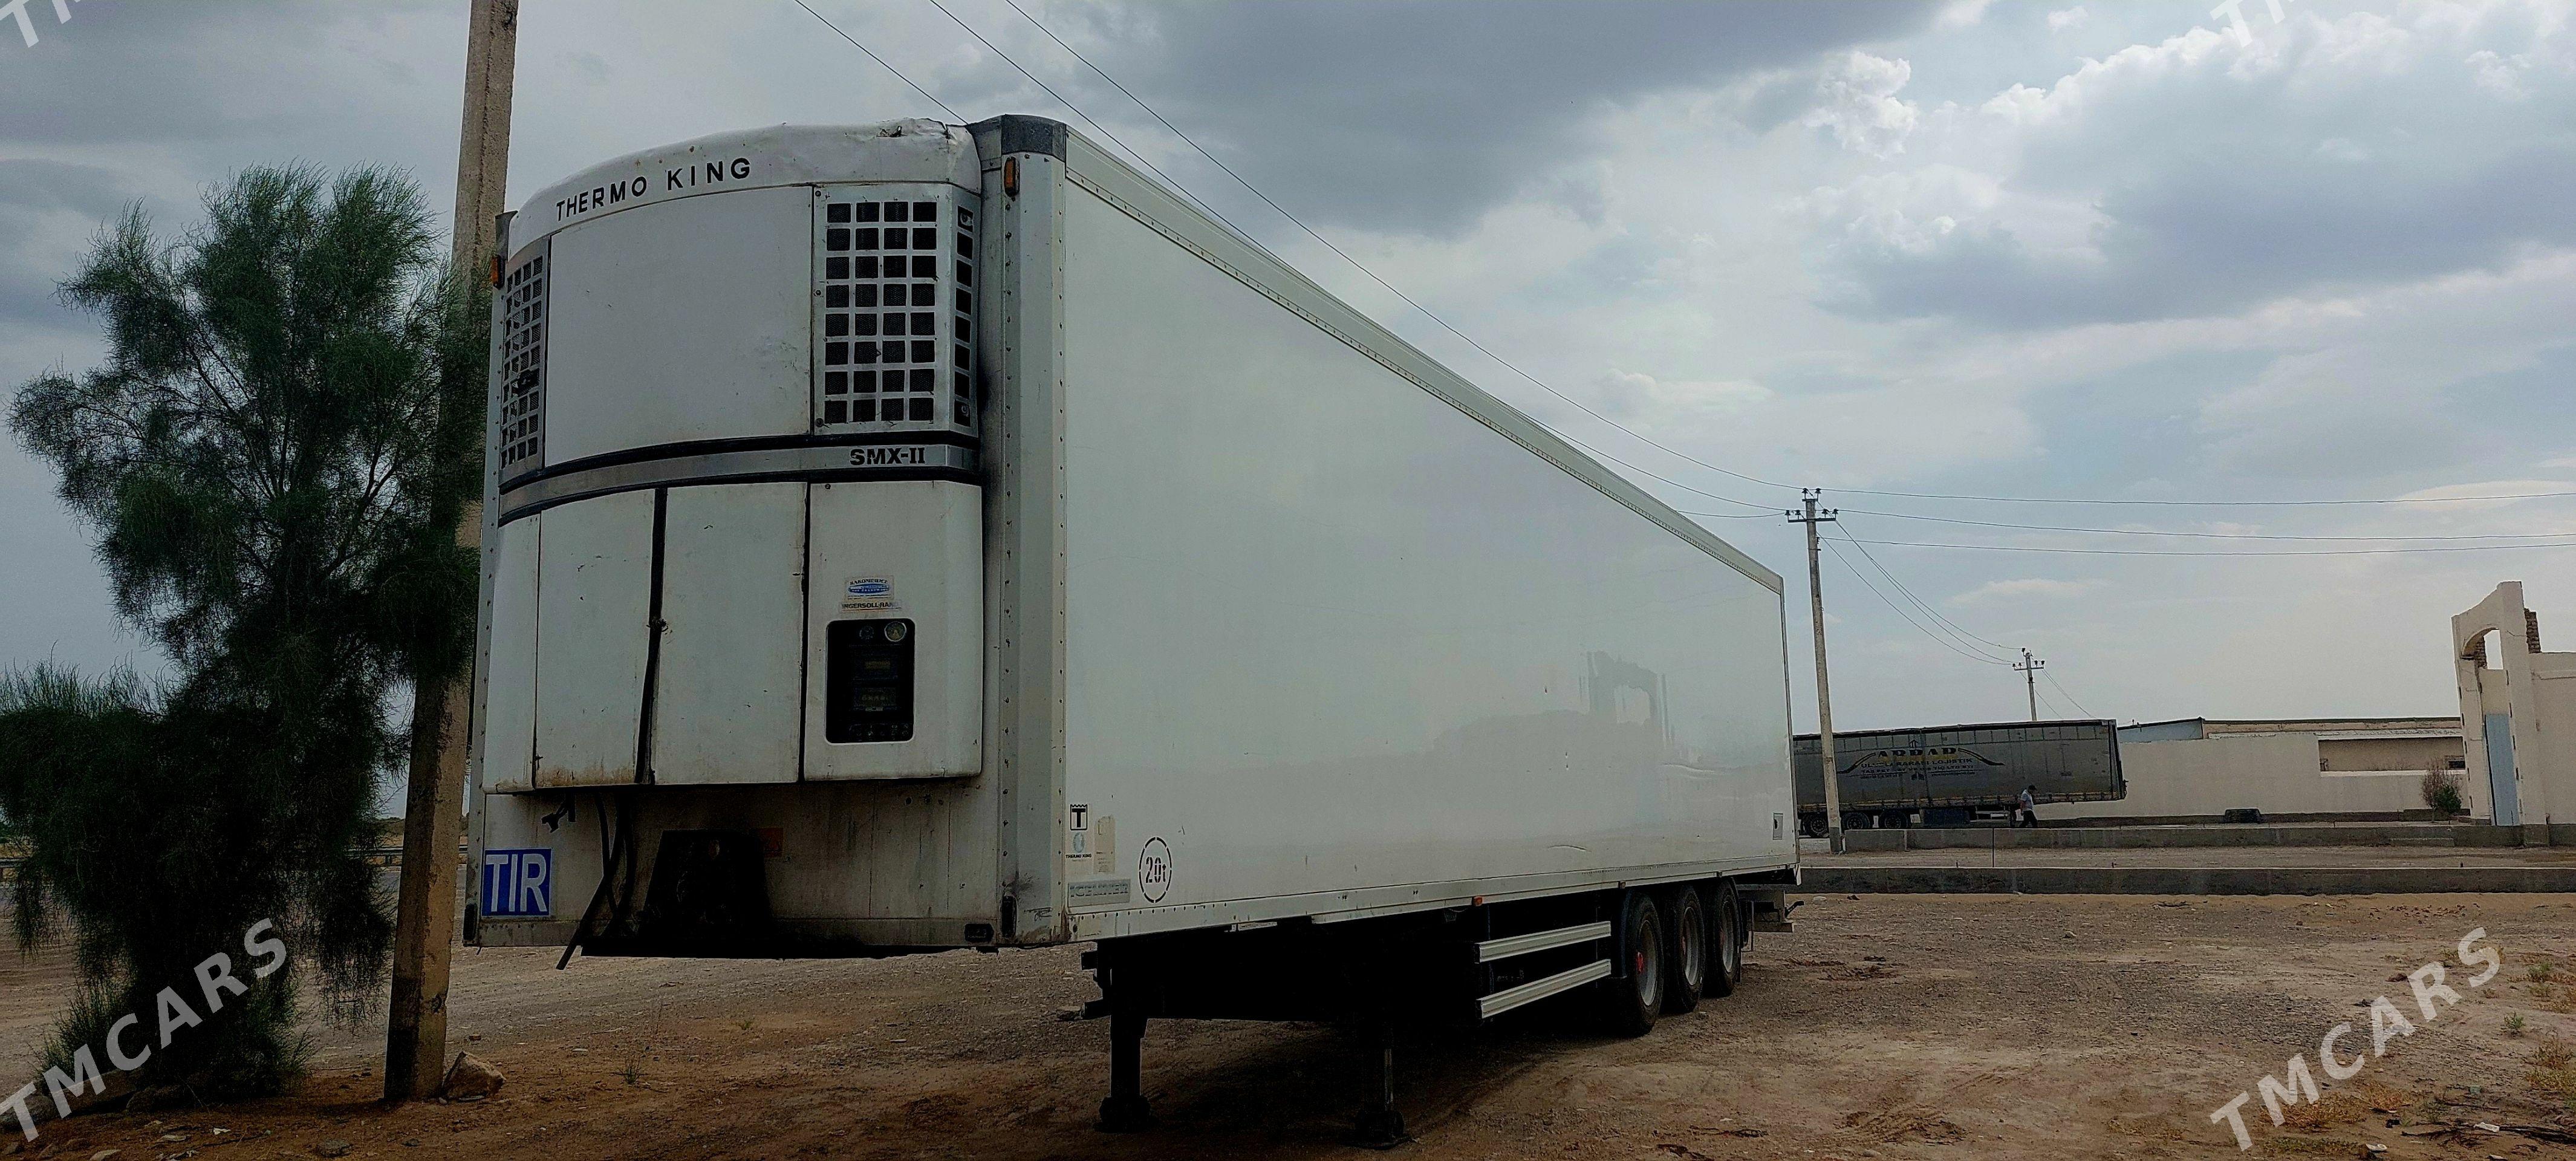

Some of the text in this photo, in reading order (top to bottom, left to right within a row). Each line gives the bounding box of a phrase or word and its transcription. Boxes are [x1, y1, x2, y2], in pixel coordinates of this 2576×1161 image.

[556, 157, 752, 222] THERMO KING
[849, 446, 926, 466] SMX-II
[1072, 808, 1086, 828] T
[486, 853, 548, 912] TIR
[1145, 856, 1166, 883] 20t
